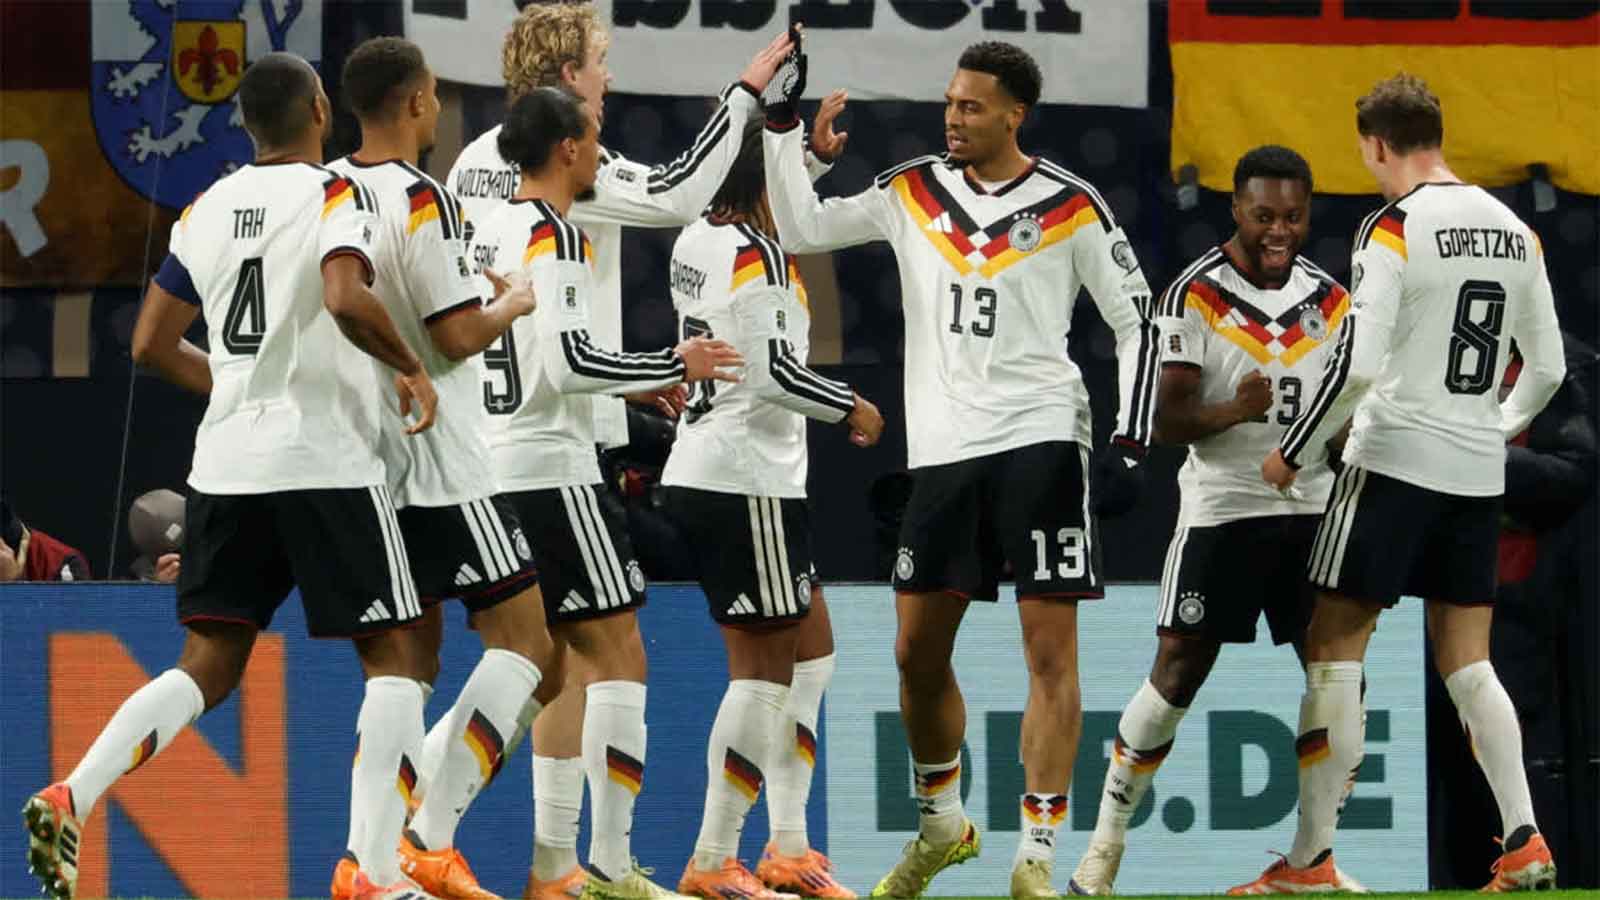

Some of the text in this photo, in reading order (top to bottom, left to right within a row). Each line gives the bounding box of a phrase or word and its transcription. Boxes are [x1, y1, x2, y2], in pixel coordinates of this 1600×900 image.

[233, 207, 266, 240] TAH
[1436, 228, 1527, 262] GORETZKA
[222, 256, 266, 355] 4
[949, 282, 997, 338] 13
[1445, 279, 1507, 396] 8
[1031, 527, 1085, 581] 13
